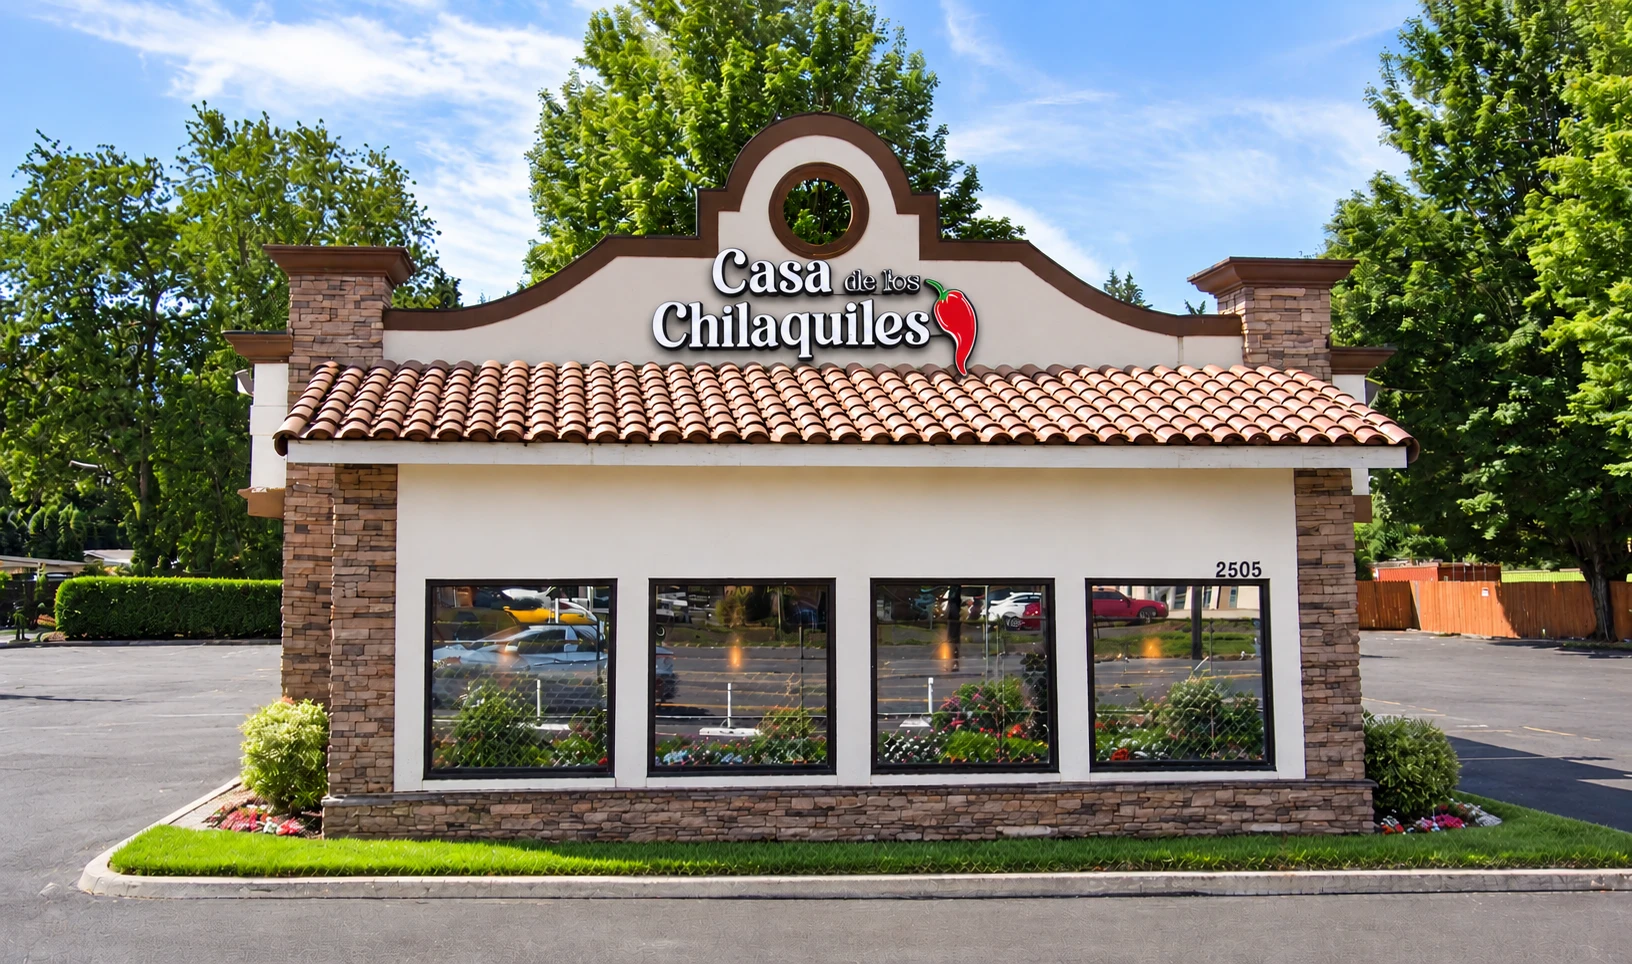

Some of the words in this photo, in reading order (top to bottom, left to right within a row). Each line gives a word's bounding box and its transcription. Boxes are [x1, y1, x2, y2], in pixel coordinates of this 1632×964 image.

[711, 248, 832, 295] Casa
[844, 269, 877, 293] de
[882, 269, 920, 293] los
[652, 300, 930, 360] Chilaquiles
[1216, 561, 1262, 578] 2505
